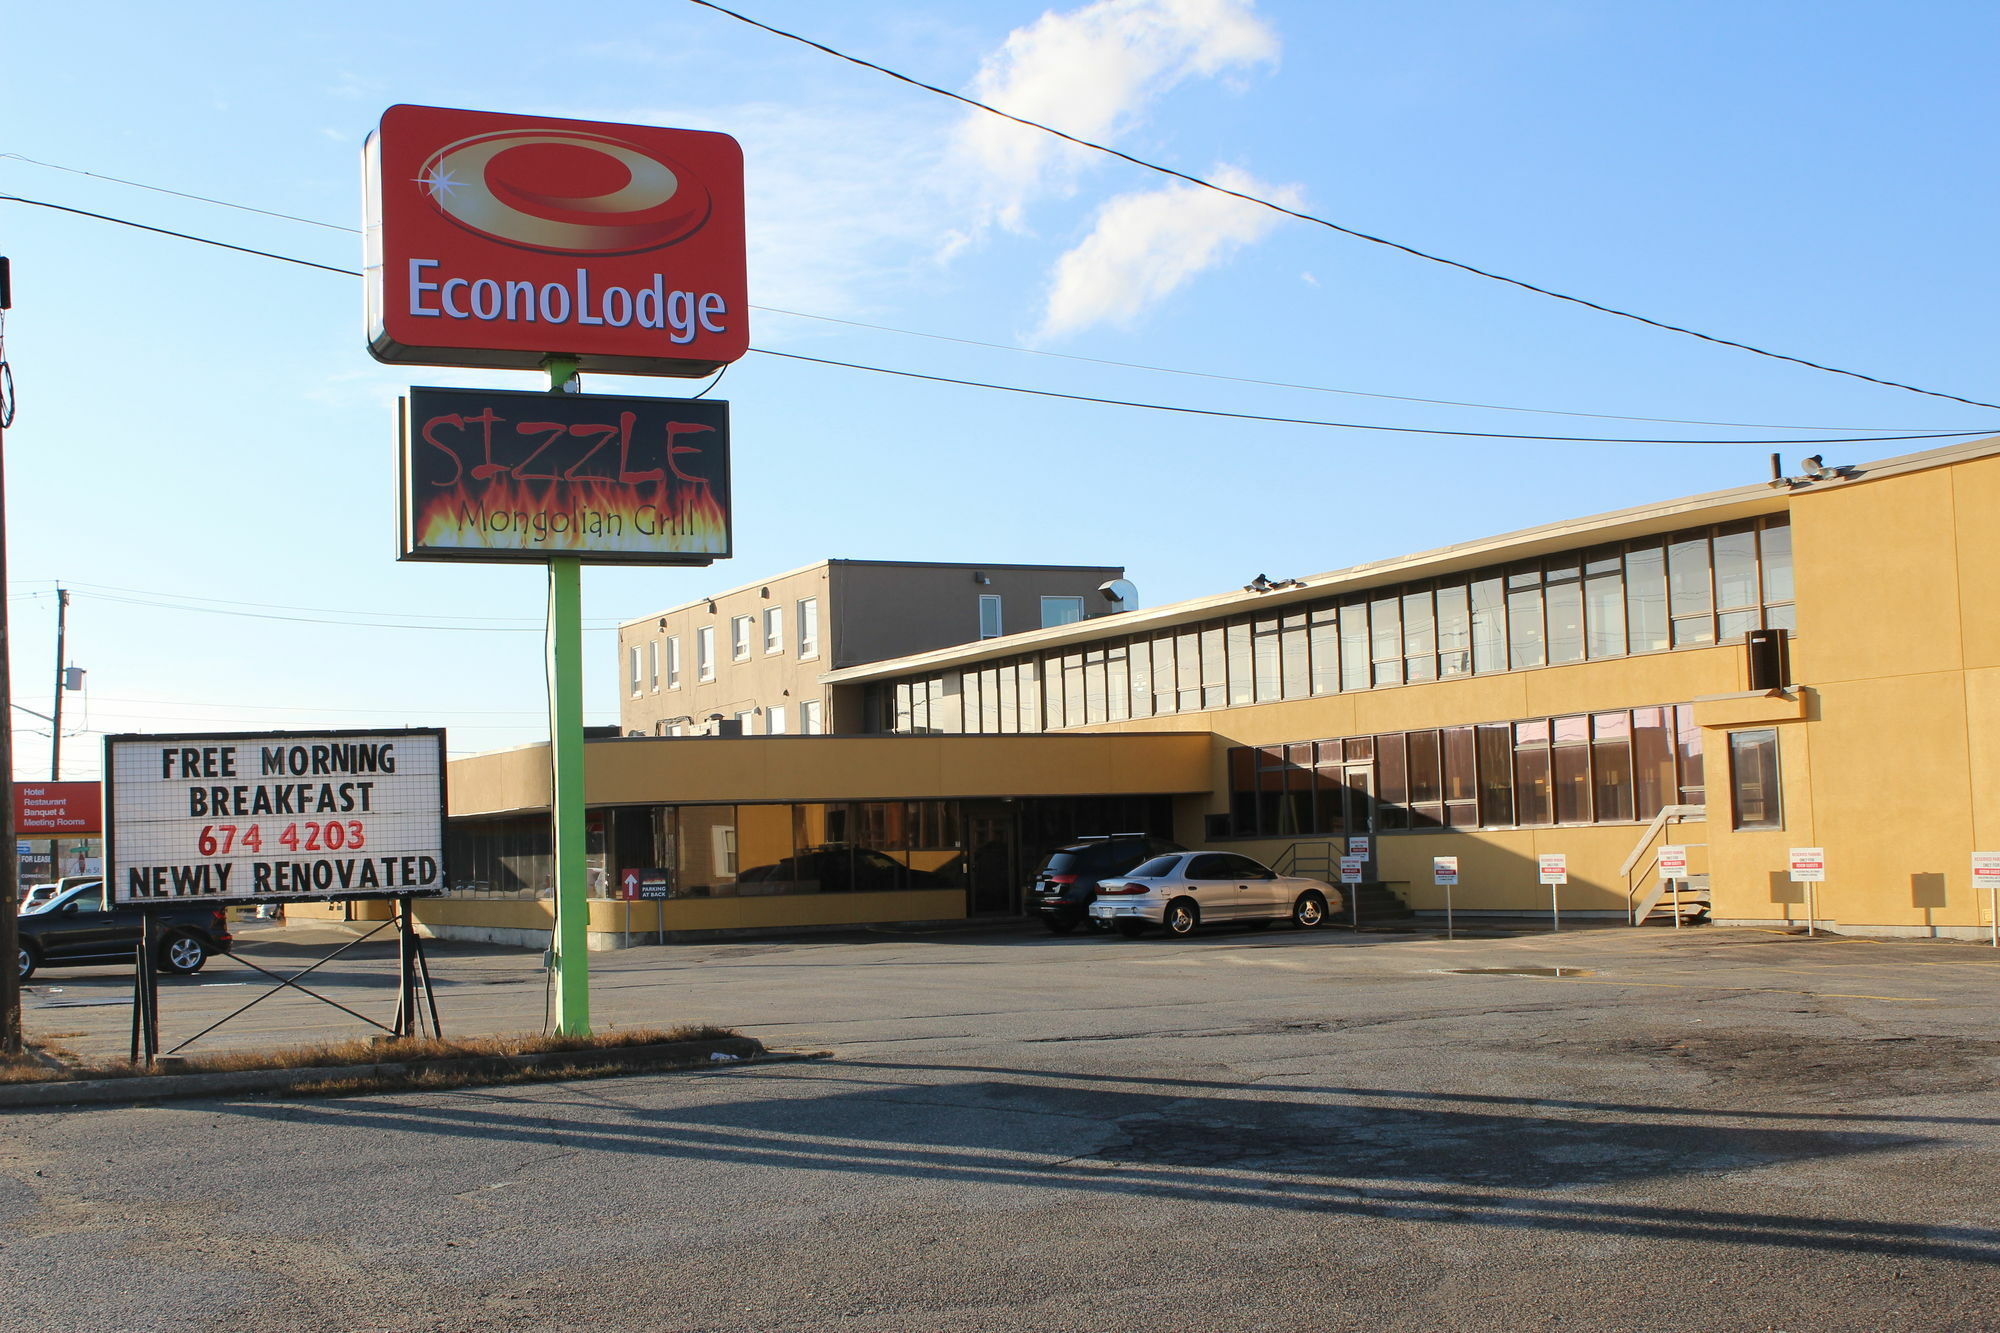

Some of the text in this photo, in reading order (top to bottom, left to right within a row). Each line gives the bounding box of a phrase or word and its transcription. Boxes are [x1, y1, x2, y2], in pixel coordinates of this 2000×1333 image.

[408, 258, 726, 343] EconoLodge
[422, 407, 716, 485] SIZZLE
[458, 497, 695, 542] Mongolian Grill
[162, 744, 395, 779] FREE MORNING
[24, 808, 57, 817] Banquet
[190, 783, 374, 817] BREAKFAST
[24, 819, 55, 827] Meeting
[198, 820, 365, 856] 674 4203
[130, 856, 436, 898] NEWLY RENOVATED
